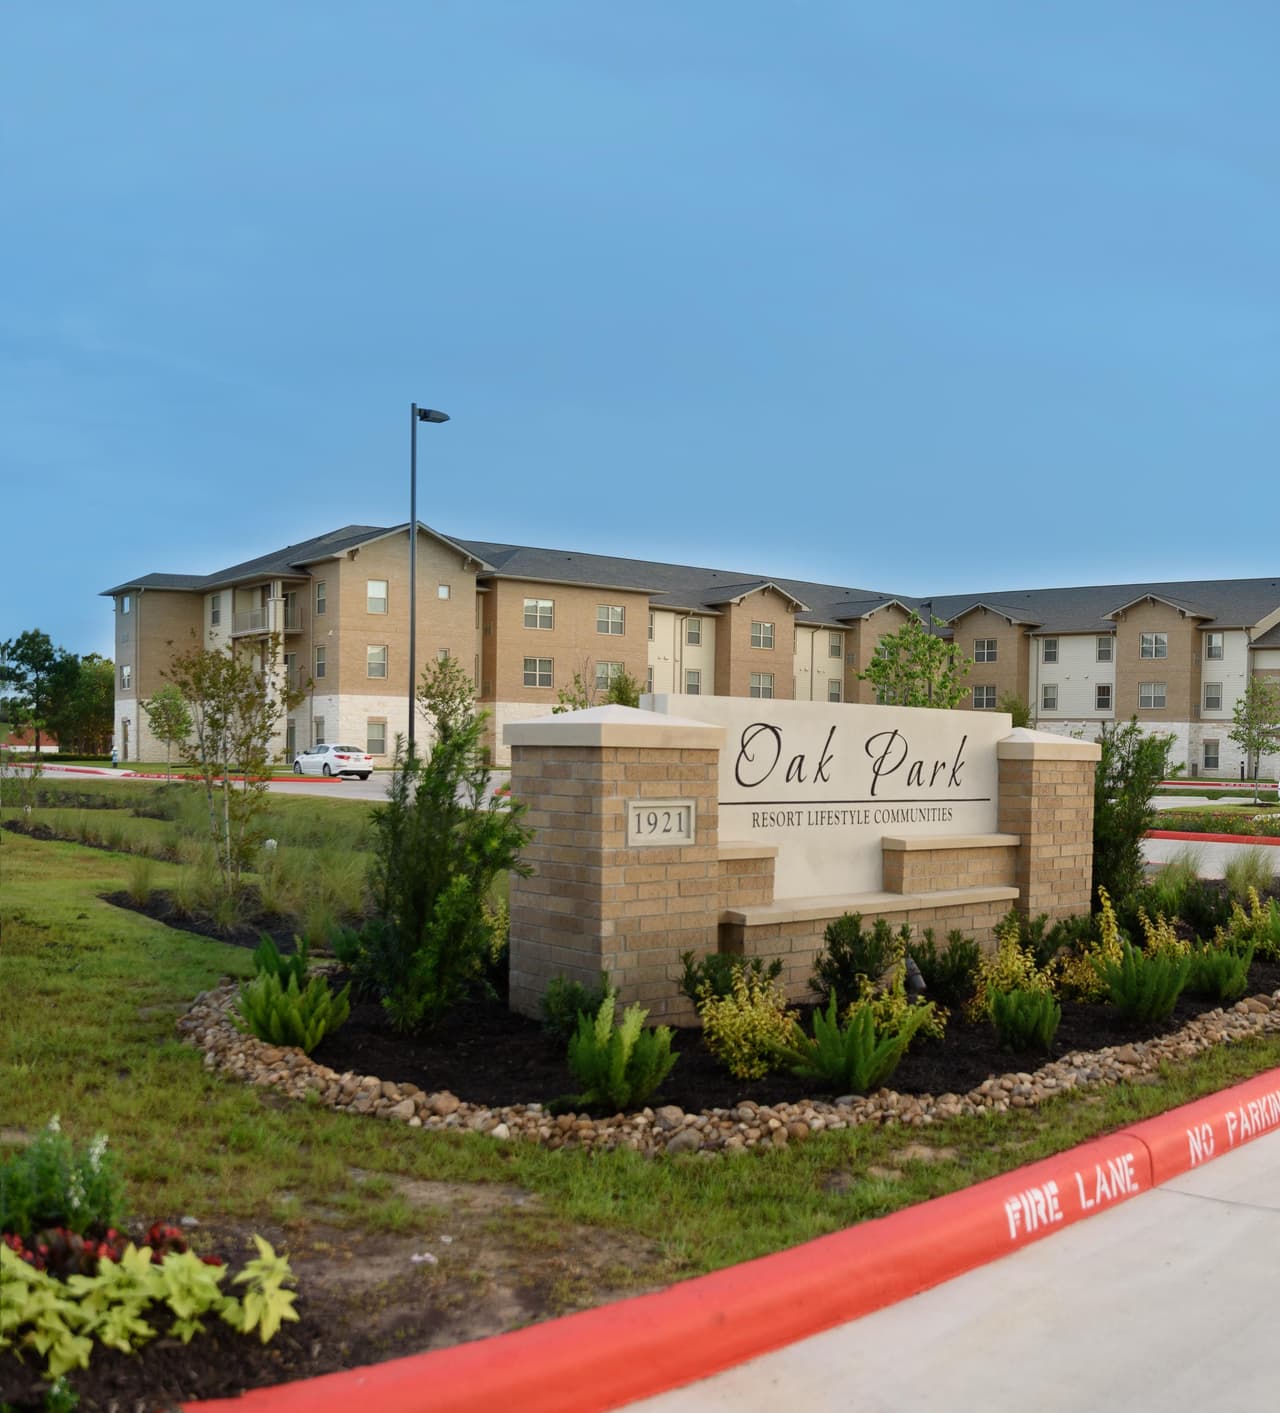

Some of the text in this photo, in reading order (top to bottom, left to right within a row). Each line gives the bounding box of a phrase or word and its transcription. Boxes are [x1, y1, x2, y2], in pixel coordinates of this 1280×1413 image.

[735, 722, 968, 796] Oak Park
[635, 811, 684, 835] 1921
[751, 807, 954, 828] RESORT LIFESTYLE COMMUNITIES
[1004, 1179, 1063, 1240] FIRE
[1075, 1152, 1139, 1210] LANE
[1186, 1122, 1215, 1166] NO
